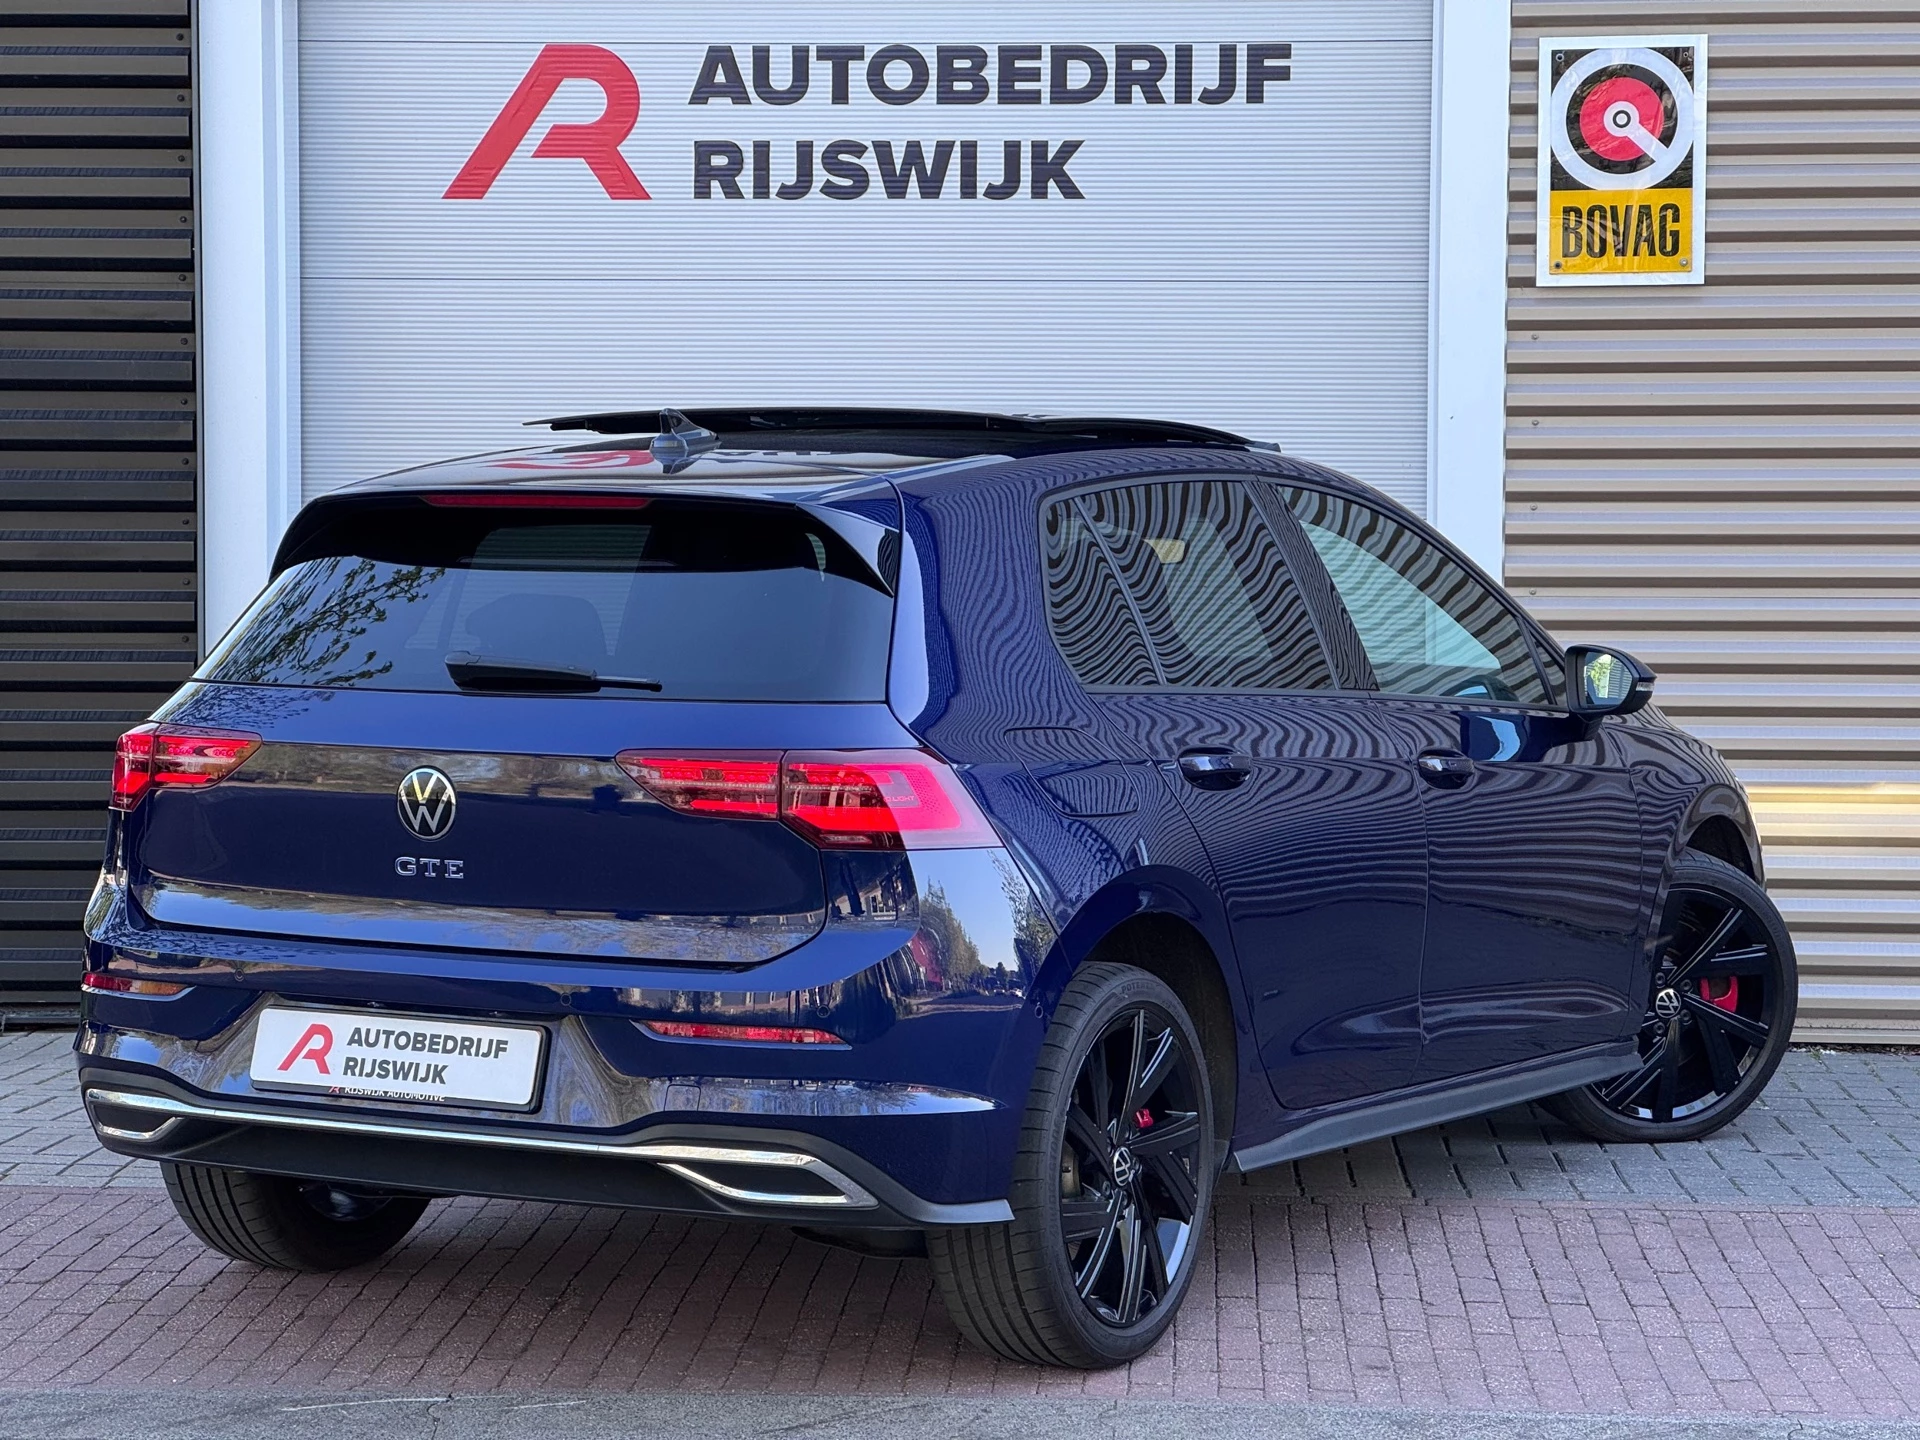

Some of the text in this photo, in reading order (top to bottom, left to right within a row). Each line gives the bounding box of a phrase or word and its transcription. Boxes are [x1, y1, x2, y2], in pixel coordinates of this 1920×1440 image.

[688, 44, 1292, 105] AUTOBEDRIJF
[693, 139, 1086, 200] RIJSWIJK
[1561, 203, 1681, 259] BOVAG
[395, 856, 464, 879] GTE
[347, 1027, 509, 1059] AUTOBEDRIJF
[343, 1057, 448, 1085] RIJSWIJK
